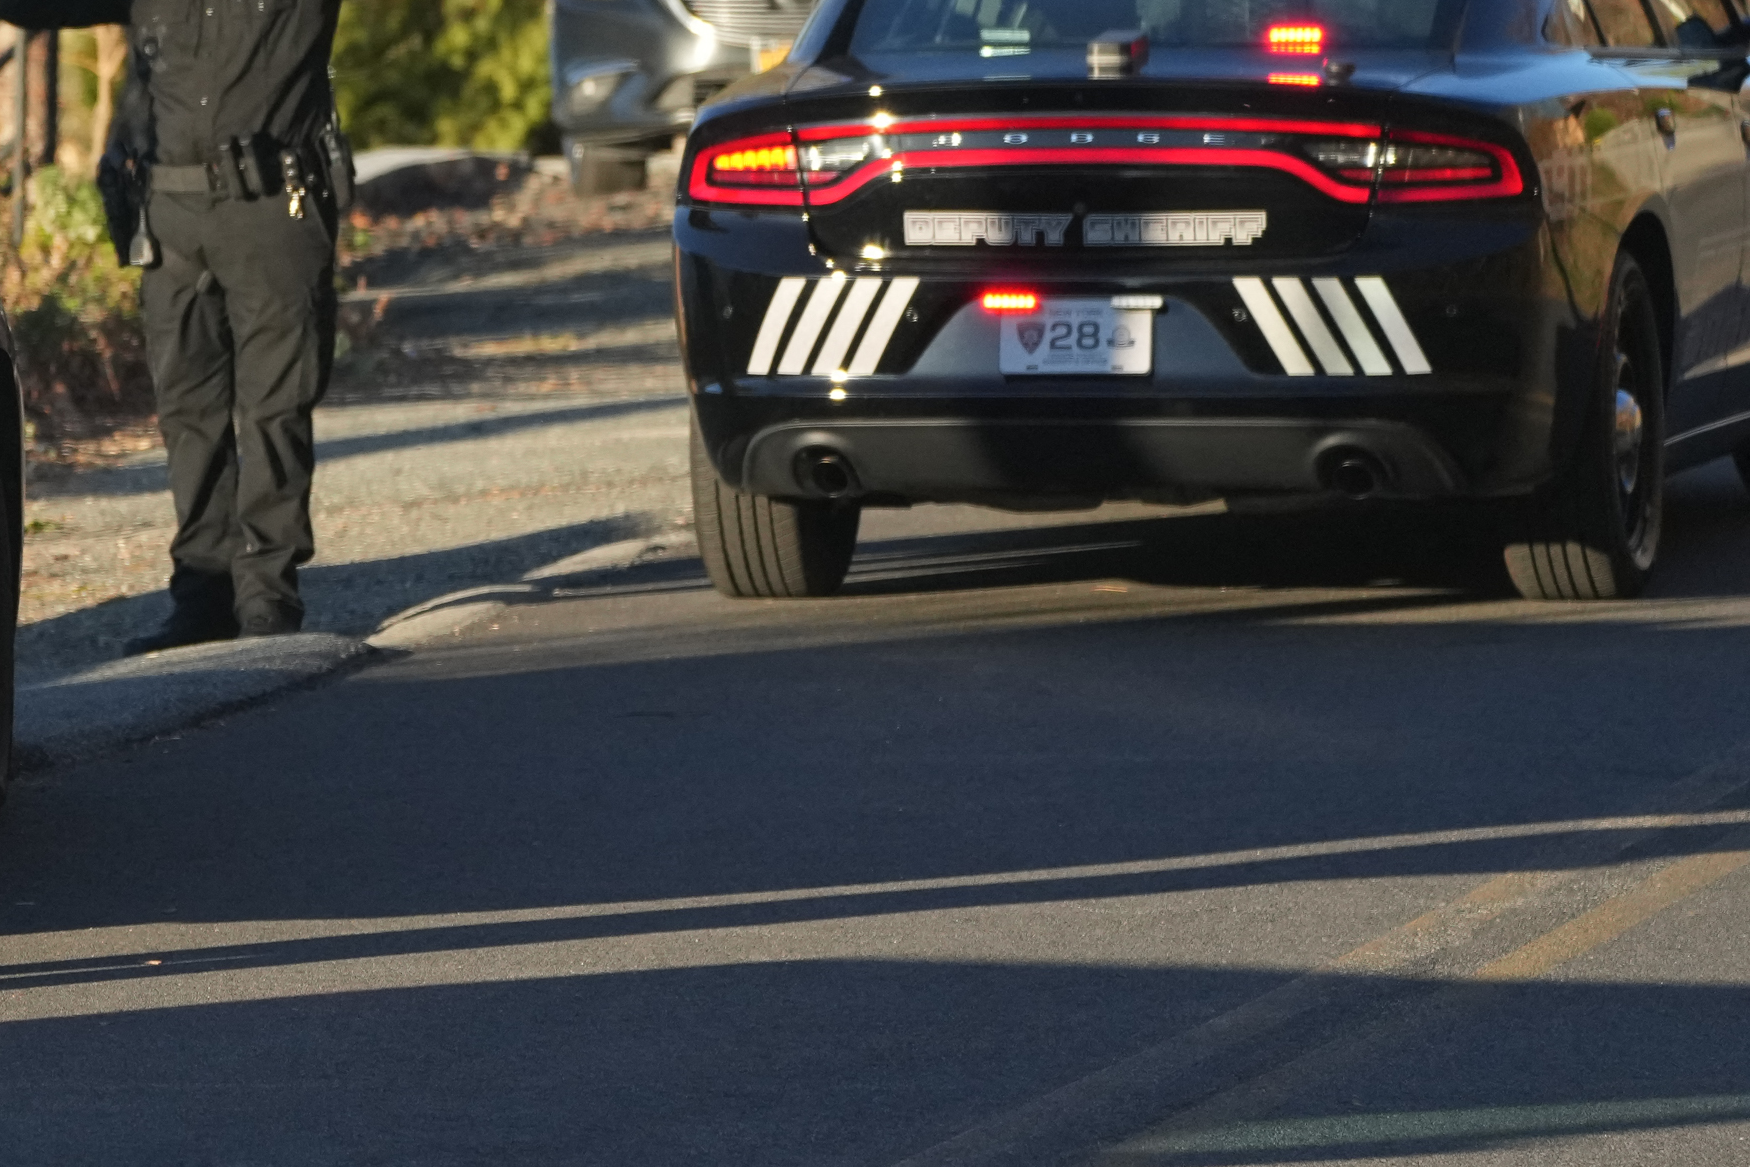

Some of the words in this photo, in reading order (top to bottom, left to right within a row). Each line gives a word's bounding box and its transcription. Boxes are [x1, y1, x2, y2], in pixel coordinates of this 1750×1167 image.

[903, 210, 1074, 246] DEPUTY
[1082, 210, 1267, 246] SHERIFF
[1049, 320, 1100, 350] 28
